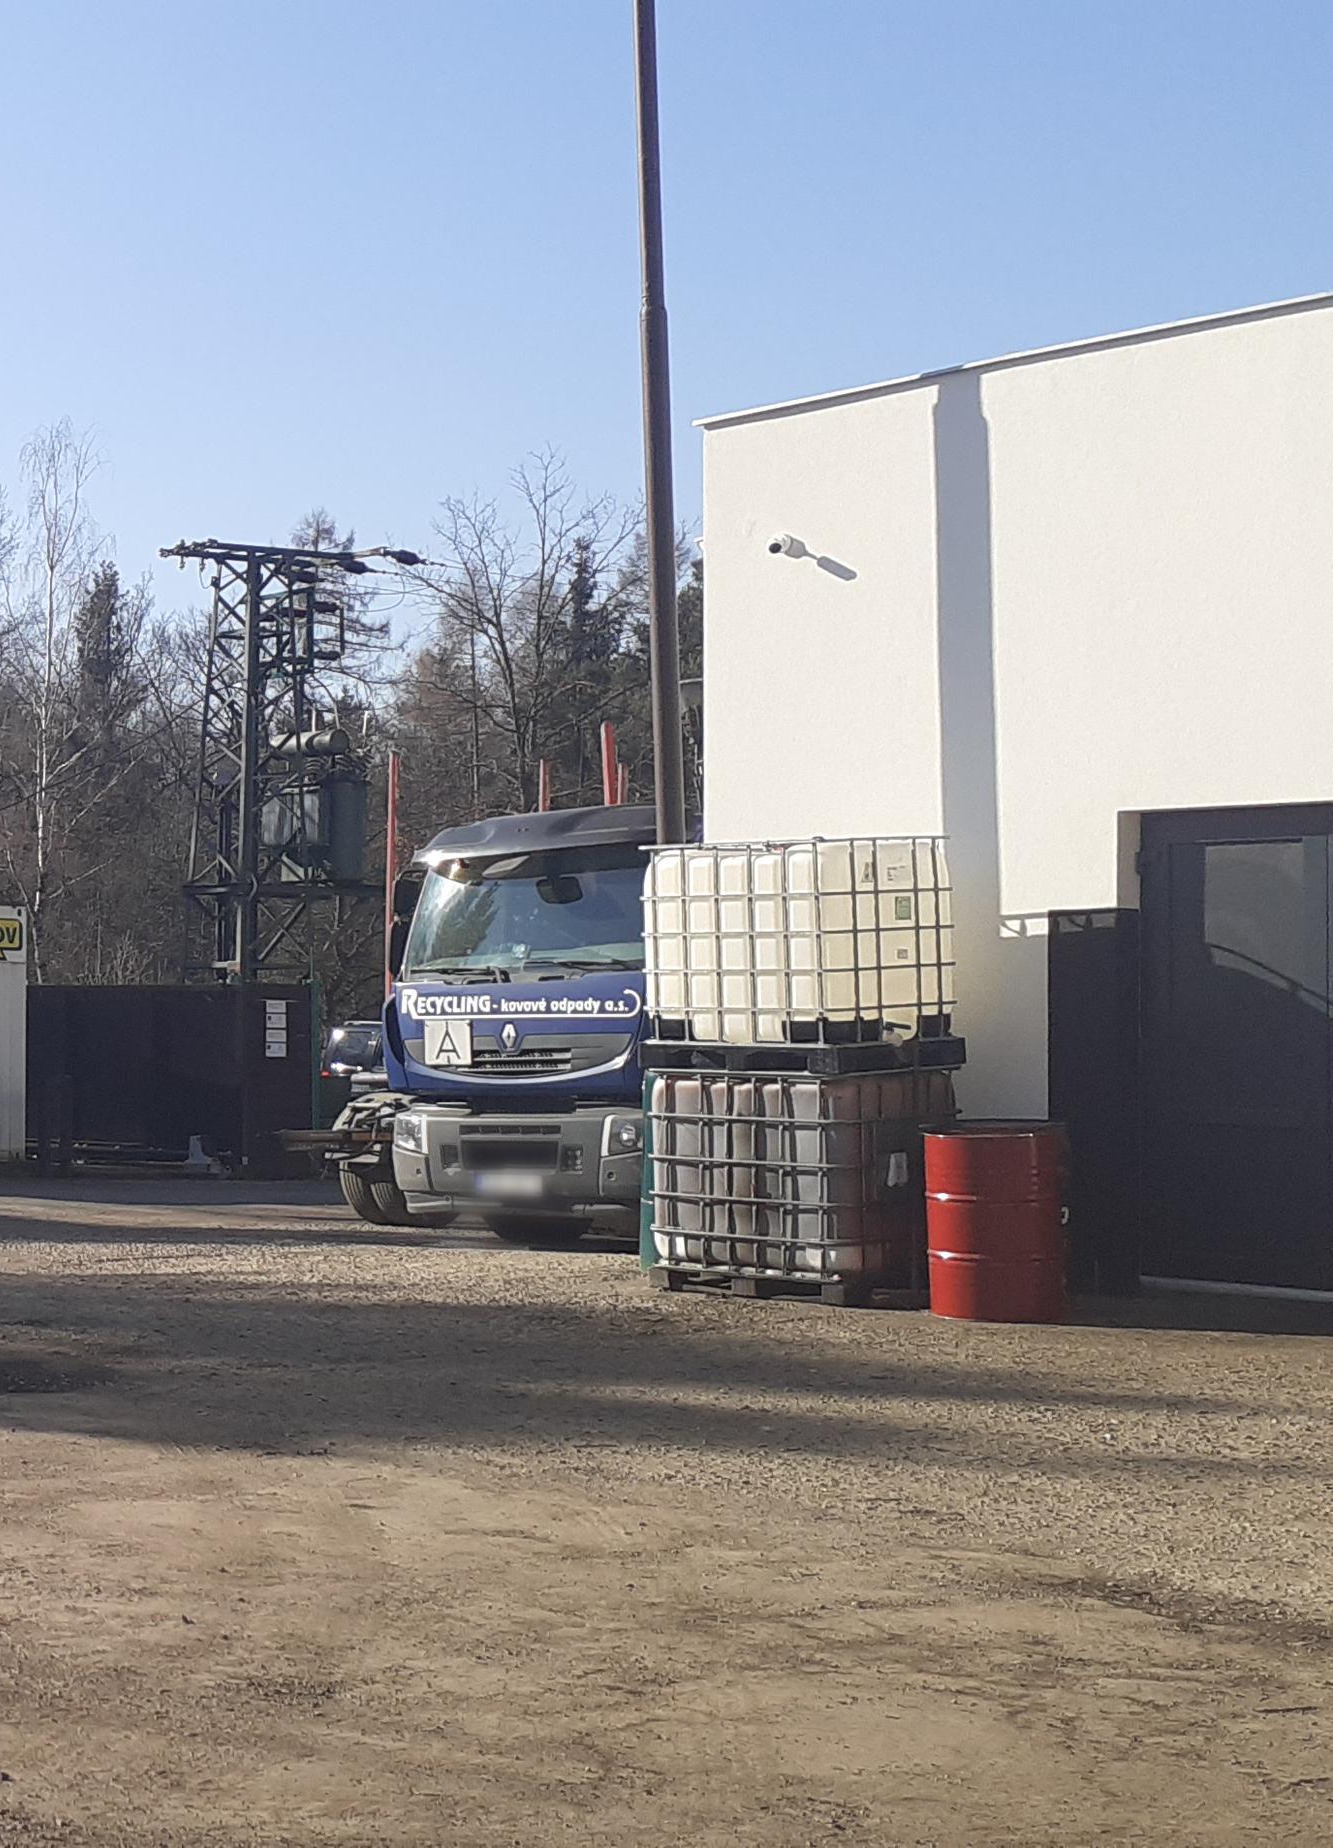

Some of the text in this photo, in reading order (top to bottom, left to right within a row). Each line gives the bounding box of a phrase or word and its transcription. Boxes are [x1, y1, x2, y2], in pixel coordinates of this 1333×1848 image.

[401, 988, 491, 1015] RECYCLING
[500, 998, 546, 1013] kovové
[550, 997, 601, 1014] odpady
[605, 1000, 630, 1012] a.s.
[435, 1027, 461, 1060] A
